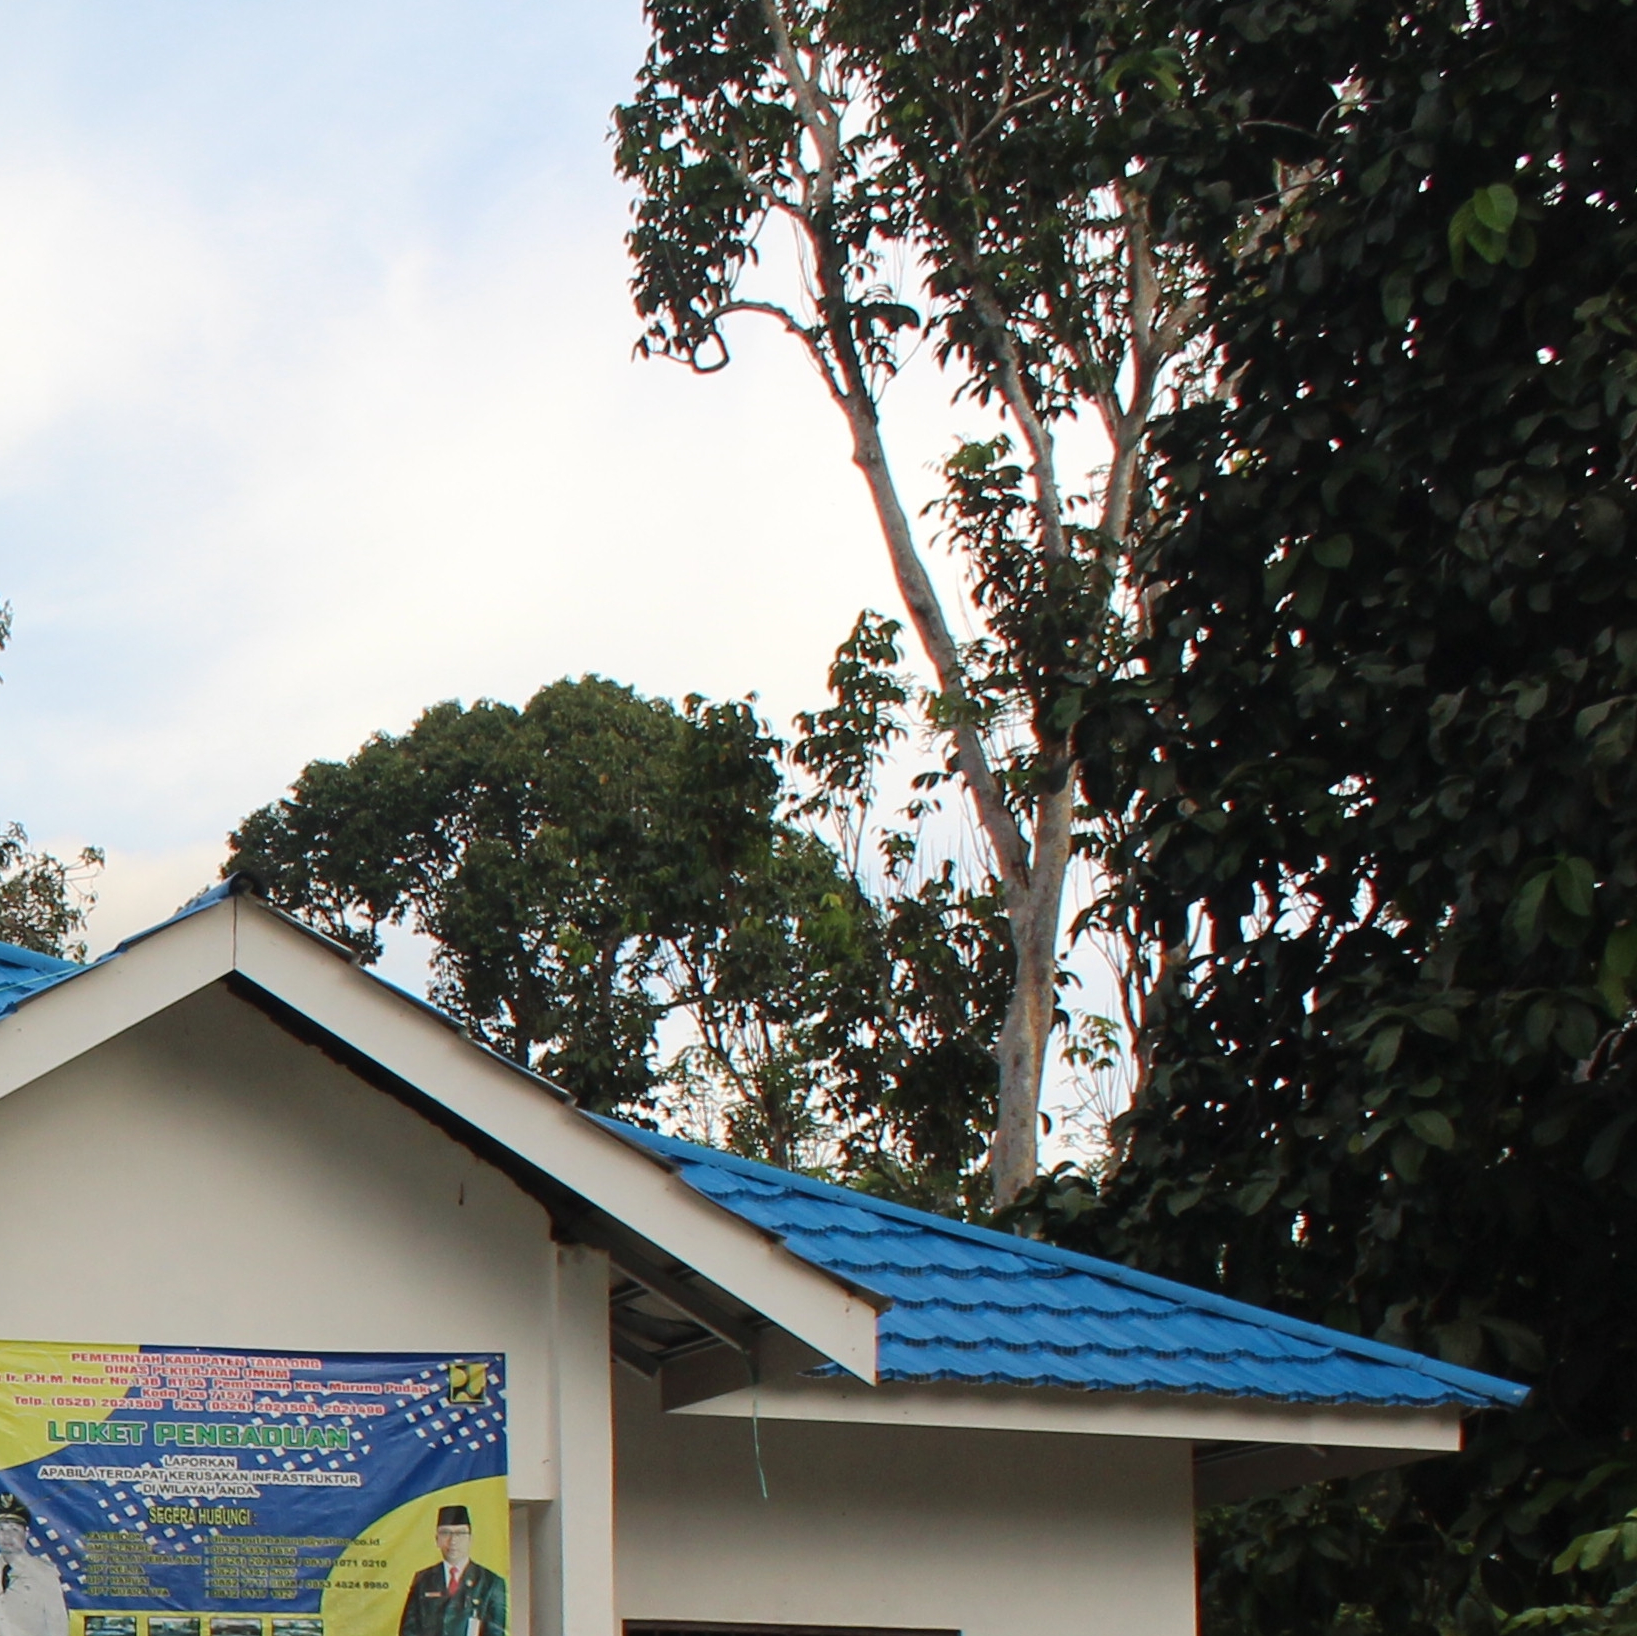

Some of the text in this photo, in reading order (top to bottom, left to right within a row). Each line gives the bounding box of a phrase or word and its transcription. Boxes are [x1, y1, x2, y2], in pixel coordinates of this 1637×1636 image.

[71, 1352, 321, 1369] PEMERINTAH KABUPATEN TABALONG
[105, 1365, 149, 1375] DINAS
[244, 1369, 289, 1379] UMUM
[72, 1375, 105, 1385] Noor
[330, 1382, 382, 1394] Murung
[14, 1395, 46, 1407] Telp.
[142, 1388, 176, 1398] Kode
[180, 1390, 207, 1399] Pos
[48, 1420, 349, 1449] LOKET PENGADUAN
[164, 1456, 236, 1468] LAPORKAN
[40, 1467, 358, 1485] APABILA TERDAPAT KERUSAKAN INFRASTRUKTUR
[143, 1484, 160, 1494] DI
[163, 1484, 216, 1496] WILAYAH
[149, 1506, 250, 1526] SEGERA HUBUNGI
